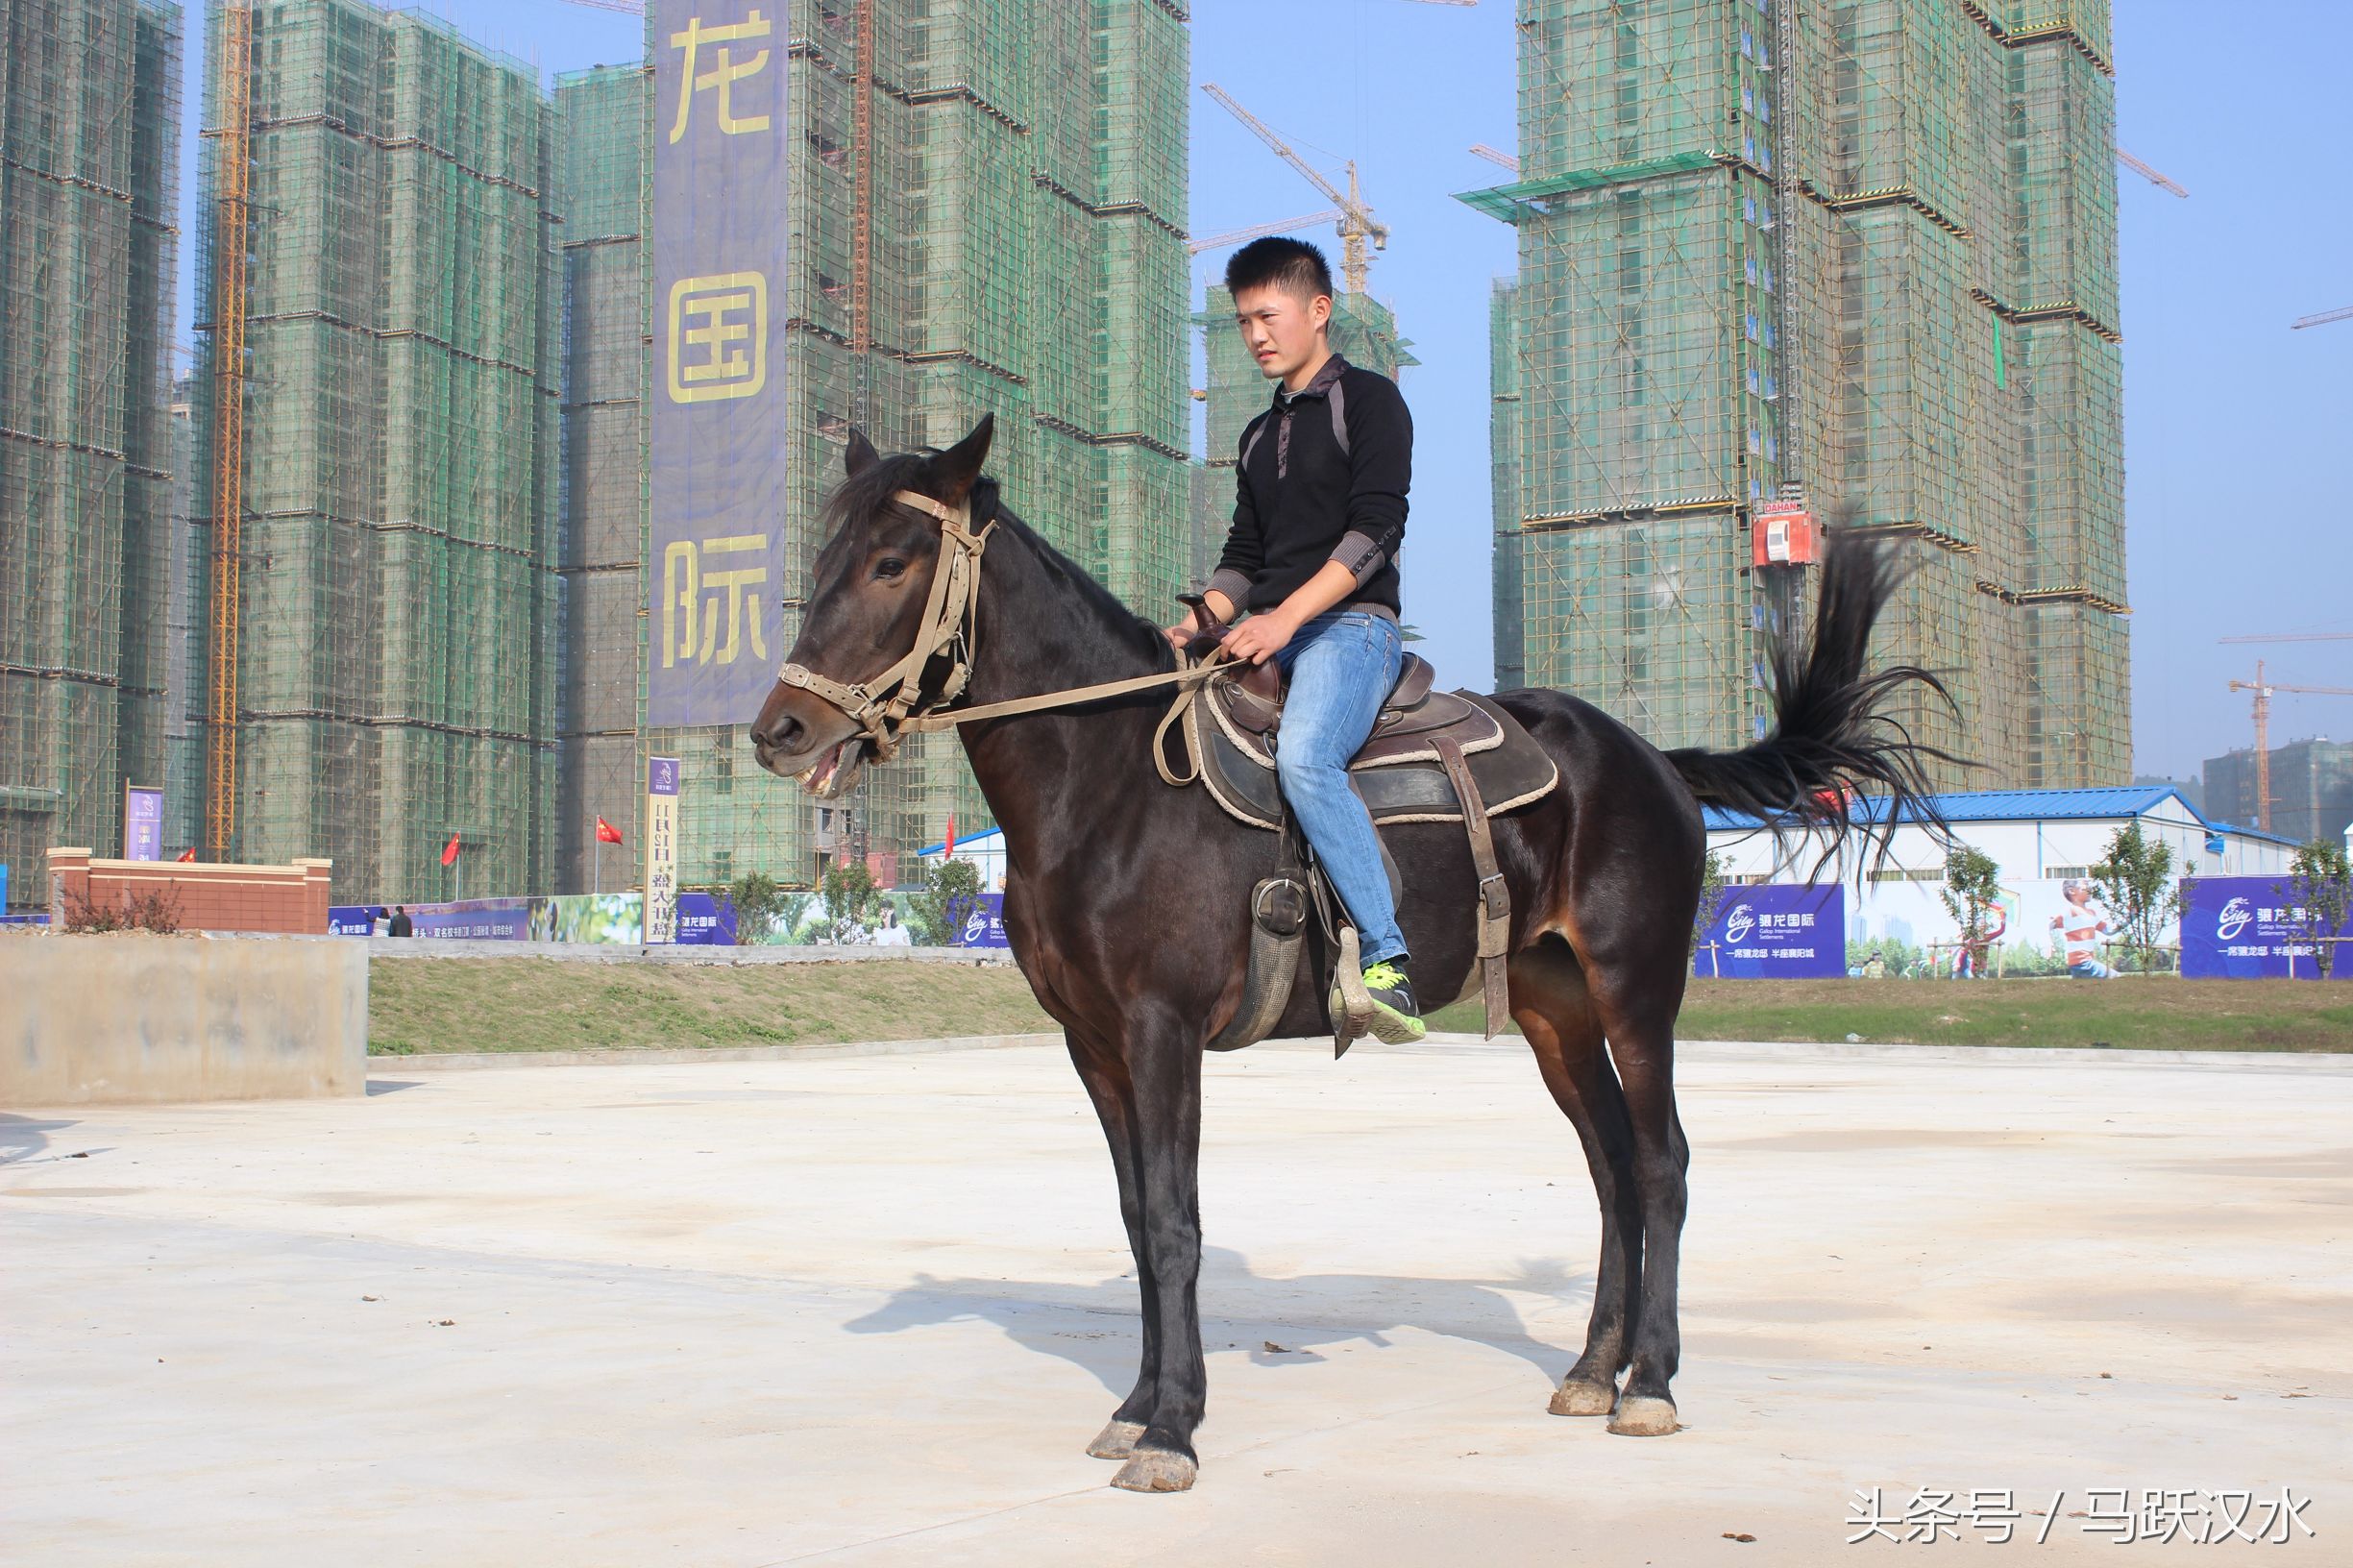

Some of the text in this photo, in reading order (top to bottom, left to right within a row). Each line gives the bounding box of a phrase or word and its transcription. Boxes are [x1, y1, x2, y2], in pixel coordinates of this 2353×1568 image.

[662, 10, 771, 669] 龙国际
[1766, 502, 1796, 512] DAHAN
